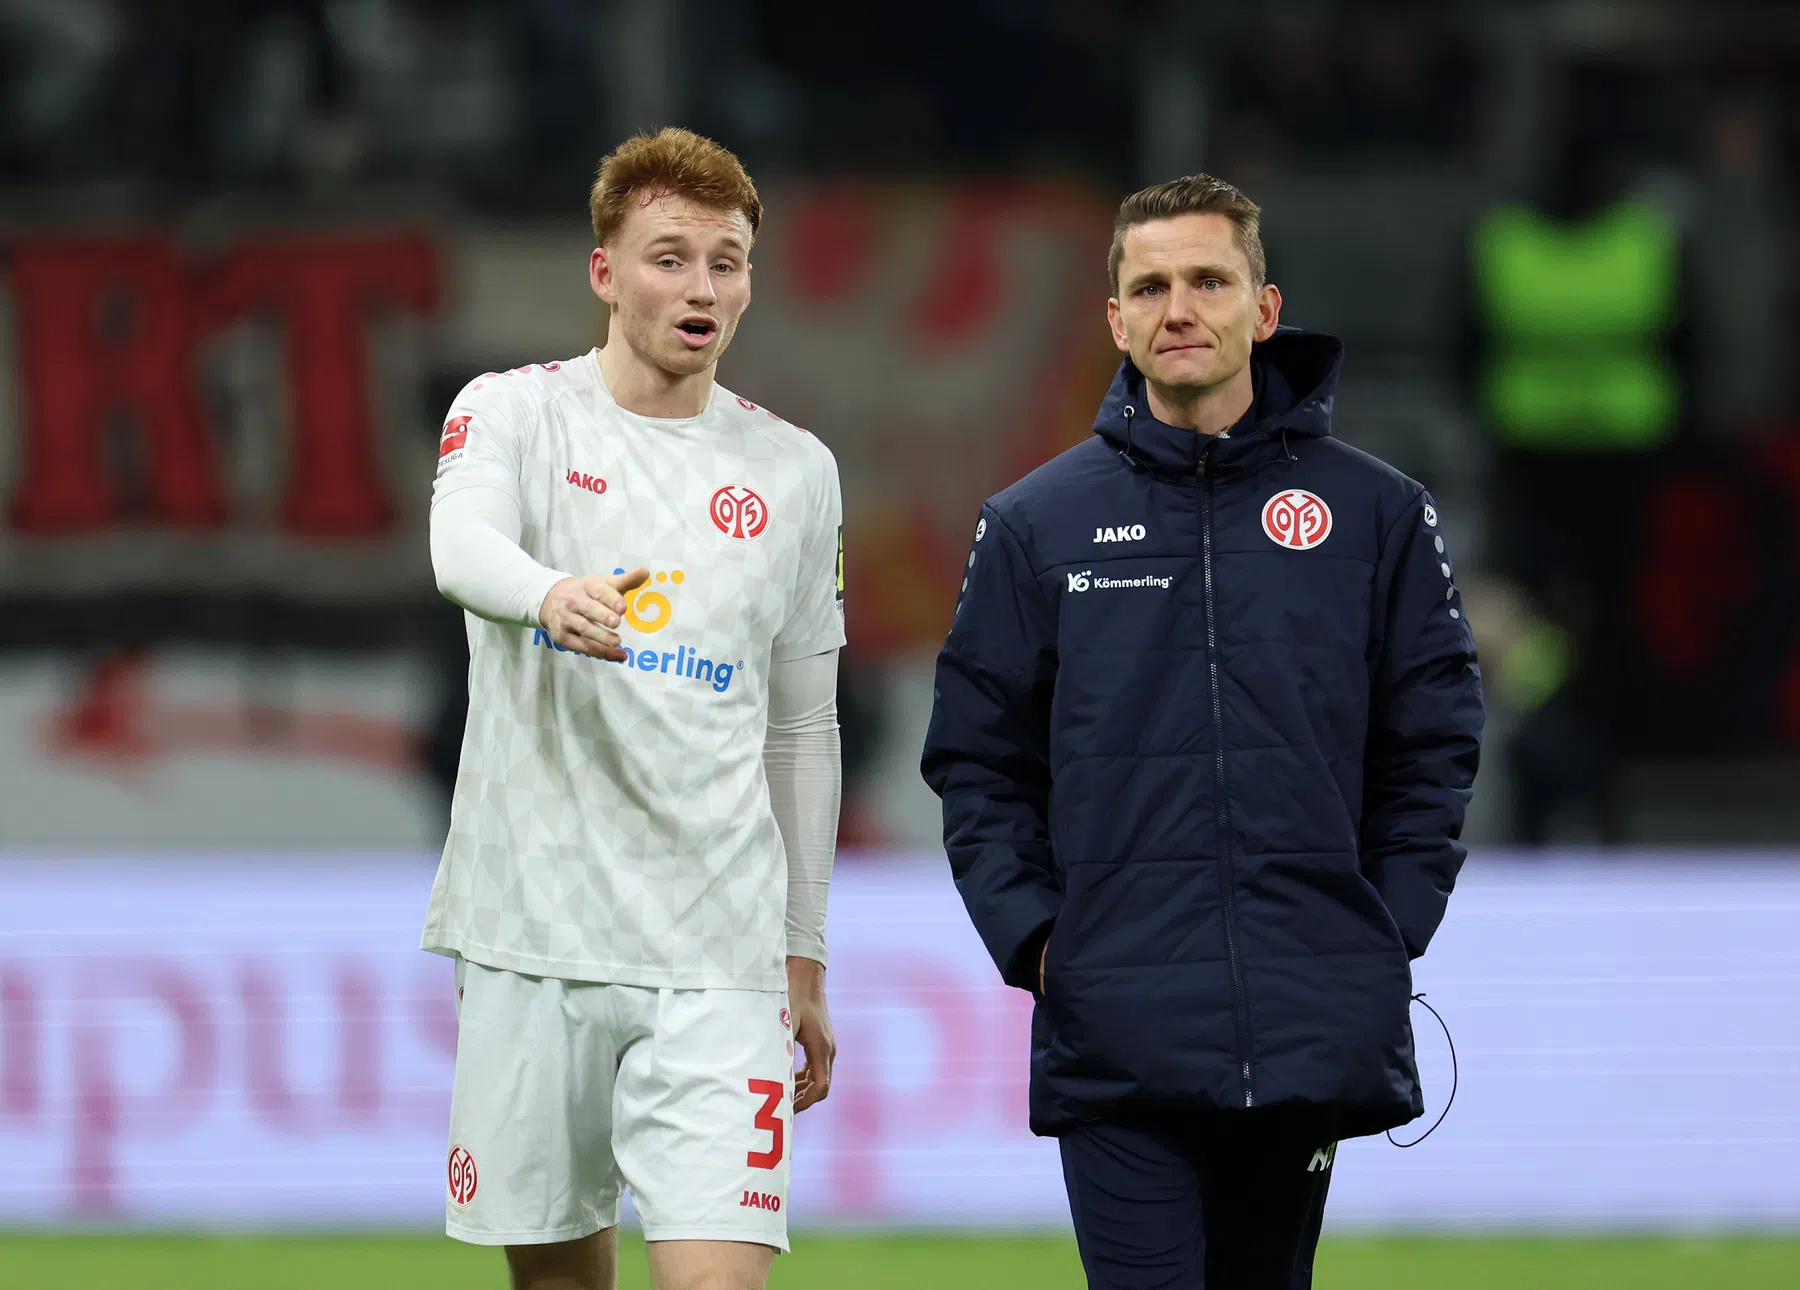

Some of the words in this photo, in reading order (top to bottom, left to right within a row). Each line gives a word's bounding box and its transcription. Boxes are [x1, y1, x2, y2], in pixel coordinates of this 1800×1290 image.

[1093, 524, 1146, 543] JAKO
[1094, 575, 1171, 589] Kömmerling
[747, 1078, 784, 1170] 3
[740, 1190, 781, 1213] JAKO
